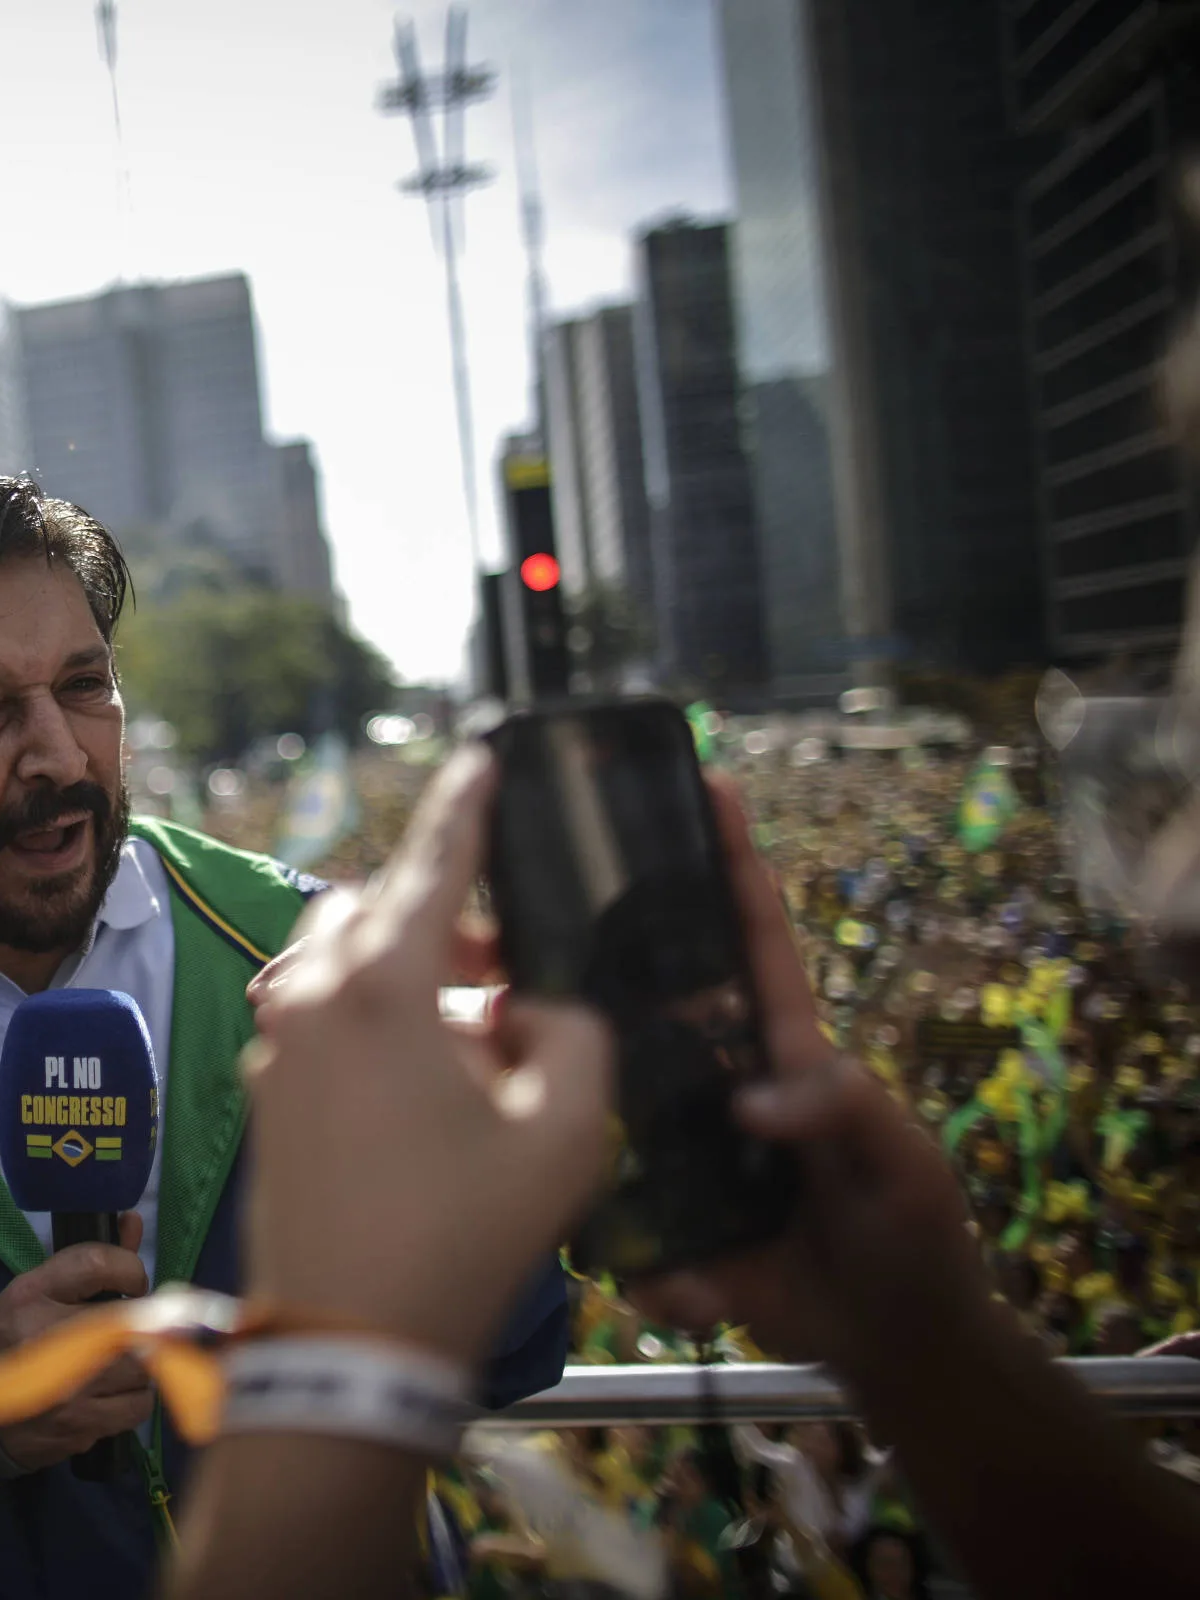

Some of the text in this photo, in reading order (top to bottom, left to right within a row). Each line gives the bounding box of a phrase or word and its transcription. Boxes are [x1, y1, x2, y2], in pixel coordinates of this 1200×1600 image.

[45, 1056, 102, 1090] PL NO
[21, 1095, 127, 1126] CONGRESSO
